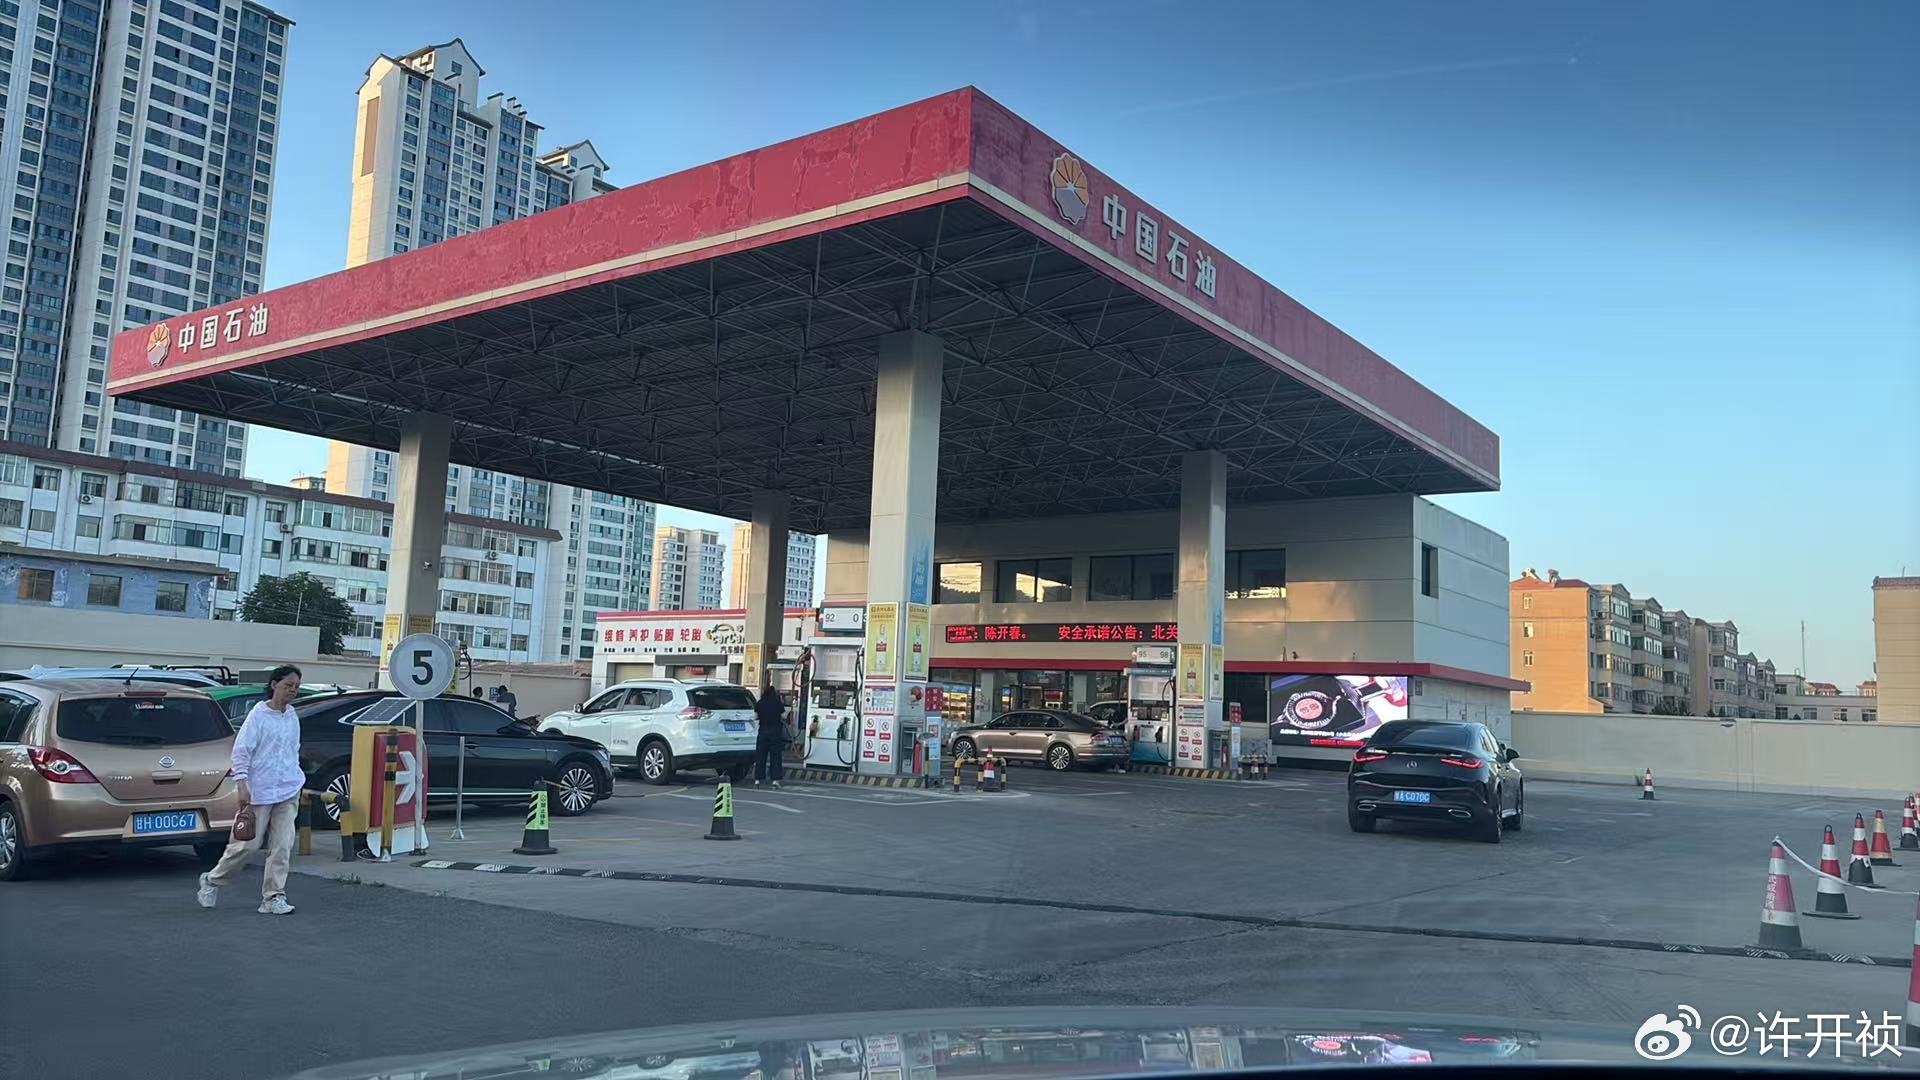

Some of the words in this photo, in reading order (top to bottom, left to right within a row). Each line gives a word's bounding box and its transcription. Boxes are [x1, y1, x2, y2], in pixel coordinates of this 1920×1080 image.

[1102, 194, 1217, 299] 中国石油
[178, 302, 268, 354] 中国石油
[604, 629, 624, 642] 维修
[629, 629, 650, 642] 养护
[653, 628, 675, 642] 贴膜
[680, 628, 702, 642] 轮胎
[825, 613, 835, 623] 92
[411, 649, 434, 686] 5
